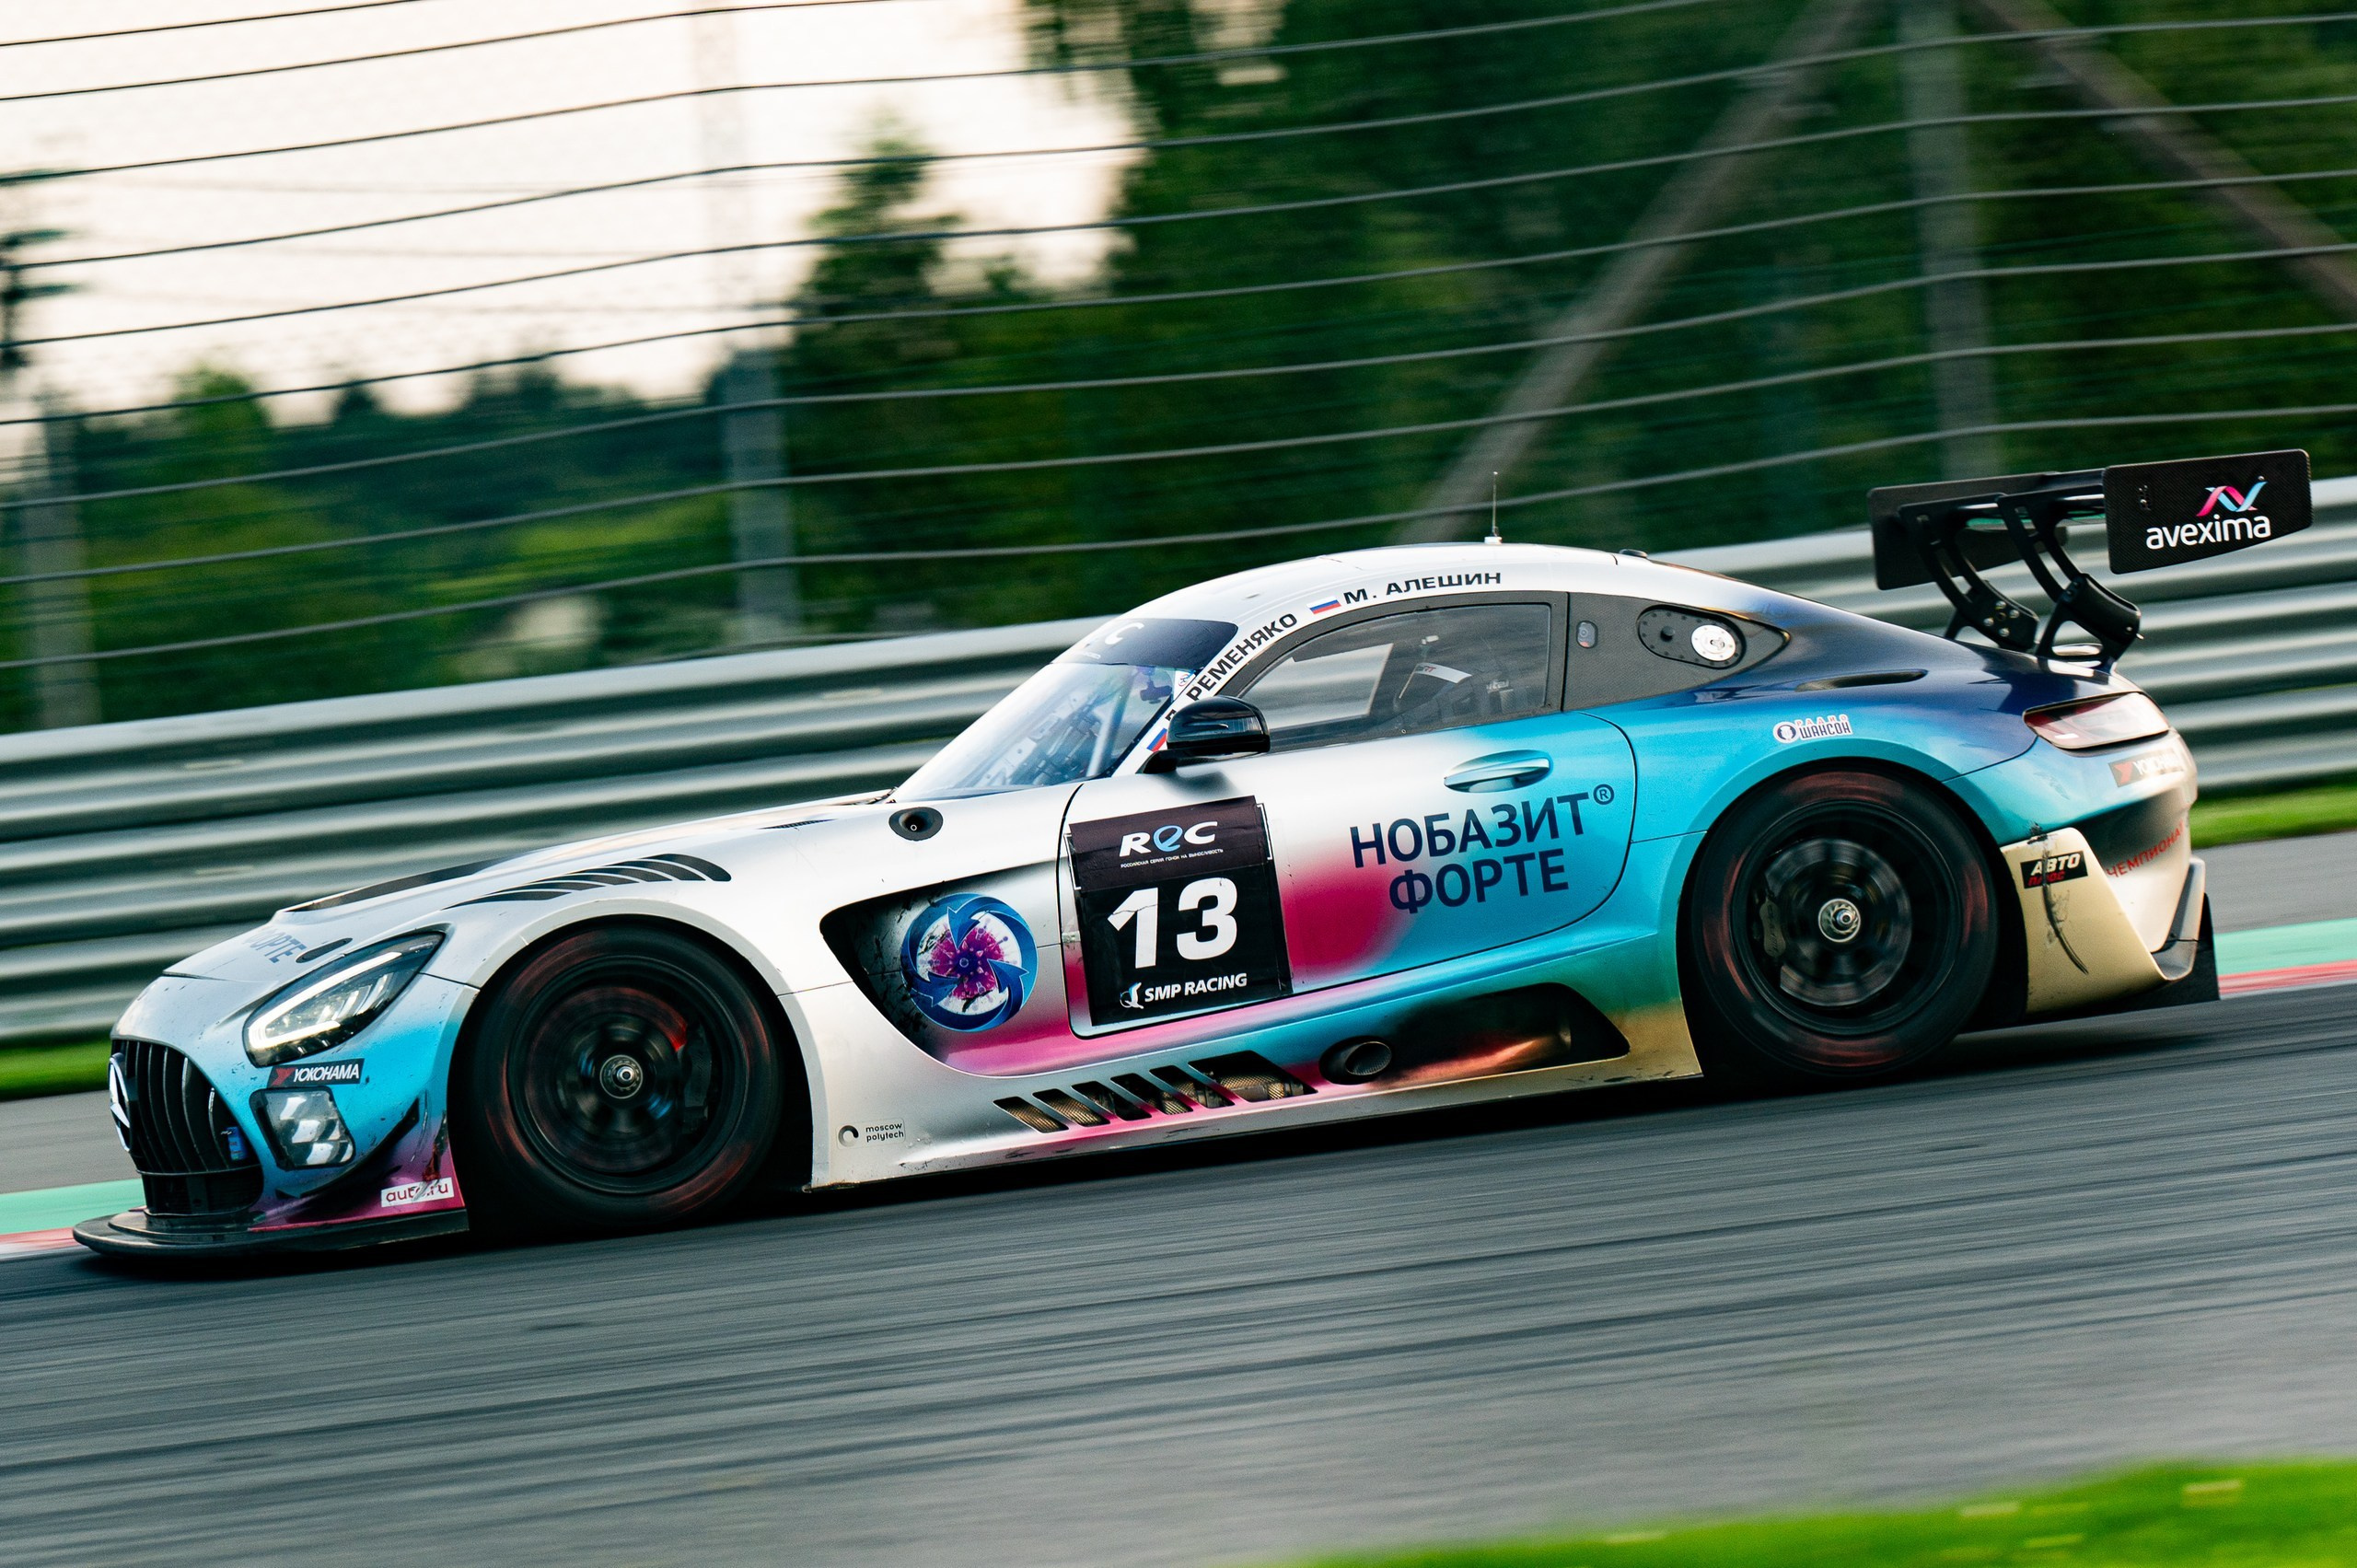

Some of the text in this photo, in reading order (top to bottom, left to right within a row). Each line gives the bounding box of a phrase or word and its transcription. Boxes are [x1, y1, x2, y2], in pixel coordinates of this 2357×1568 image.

[2145, 514, 2271, 550] avexima
[1386, 572, 1502, 596] АЛЕШИН
[1186, 613, 1298, 702] РЕМЕНЯКО
[1799, 721, 1852, 738] ШАНСОН
[2030, 853, 2081, 877] АВТО
[1388, 848, 1569, 914] ФОРТЕ
[1107, 877, 1238, 969] 13
[1144, 972, 1248, 1003] SMP RACING
[293, 1063, 360, 1083] YOKOHAMA
[865, 1122, 903, 1132] moscow
[866, 1131, 904, 1143] polytech
